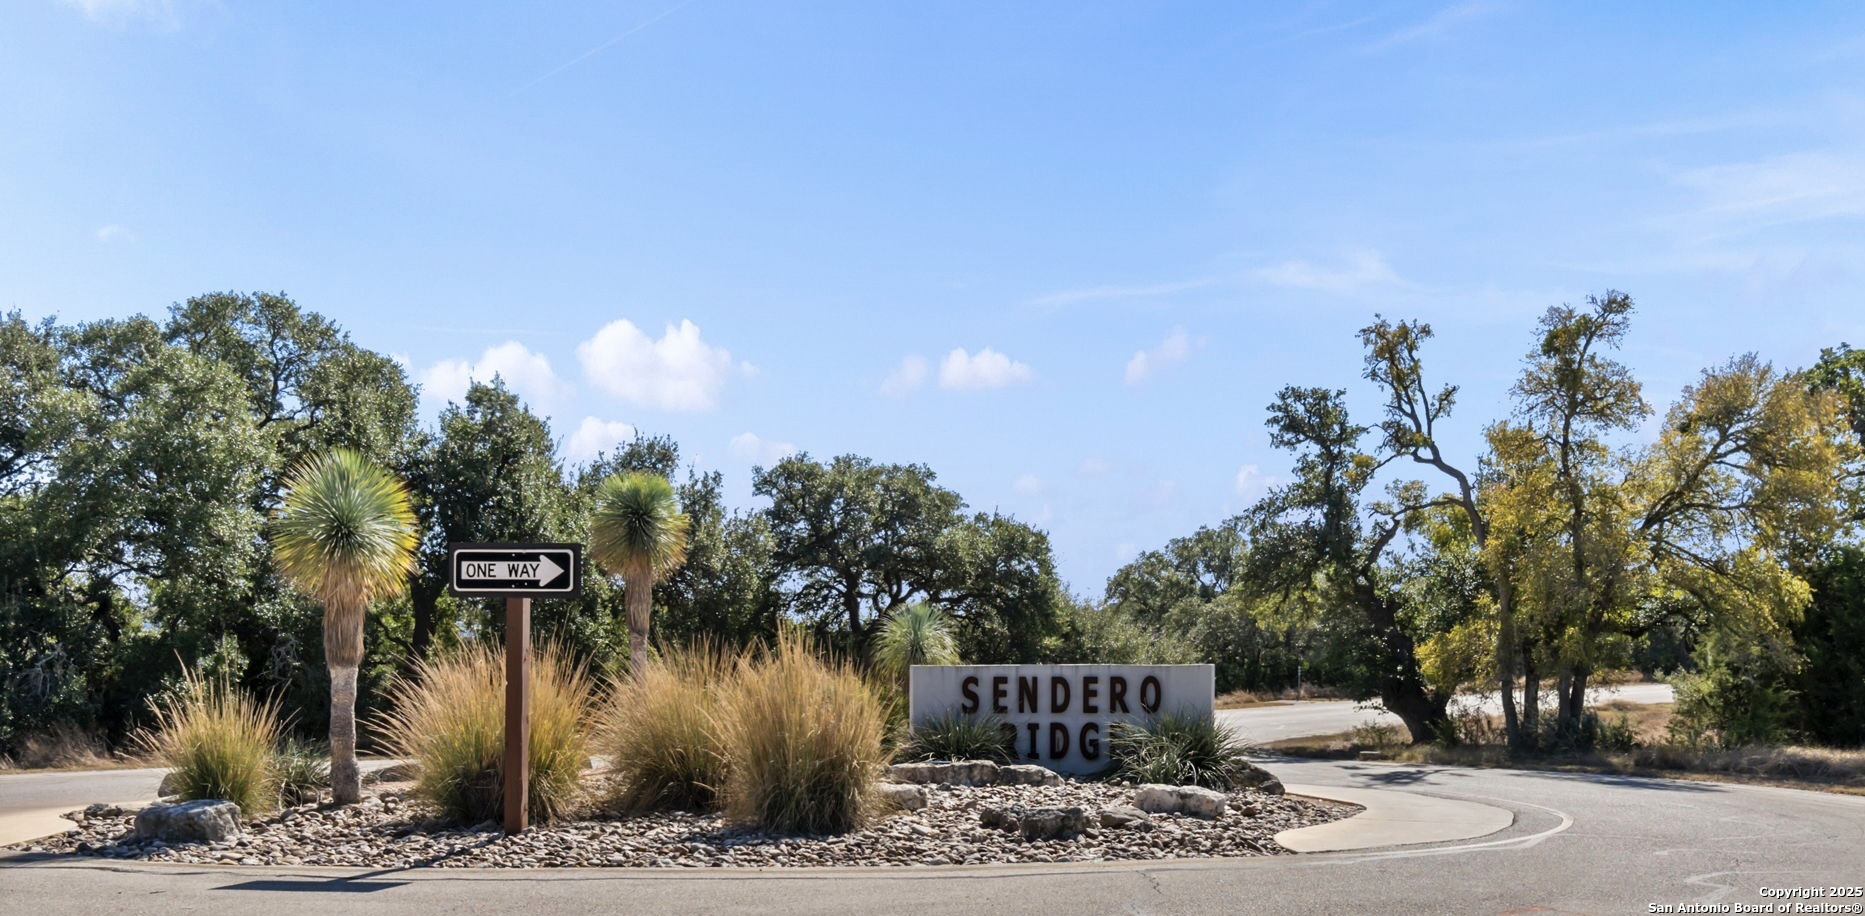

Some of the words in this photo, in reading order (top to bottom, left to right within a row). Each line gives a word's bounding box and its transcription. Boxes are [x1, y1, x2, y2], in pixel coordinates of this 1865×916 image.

[466, 563, 496, 577] ONE
[507, 563, 540, 577] WAY
[961, 676, 1161, 714] SENDERO
